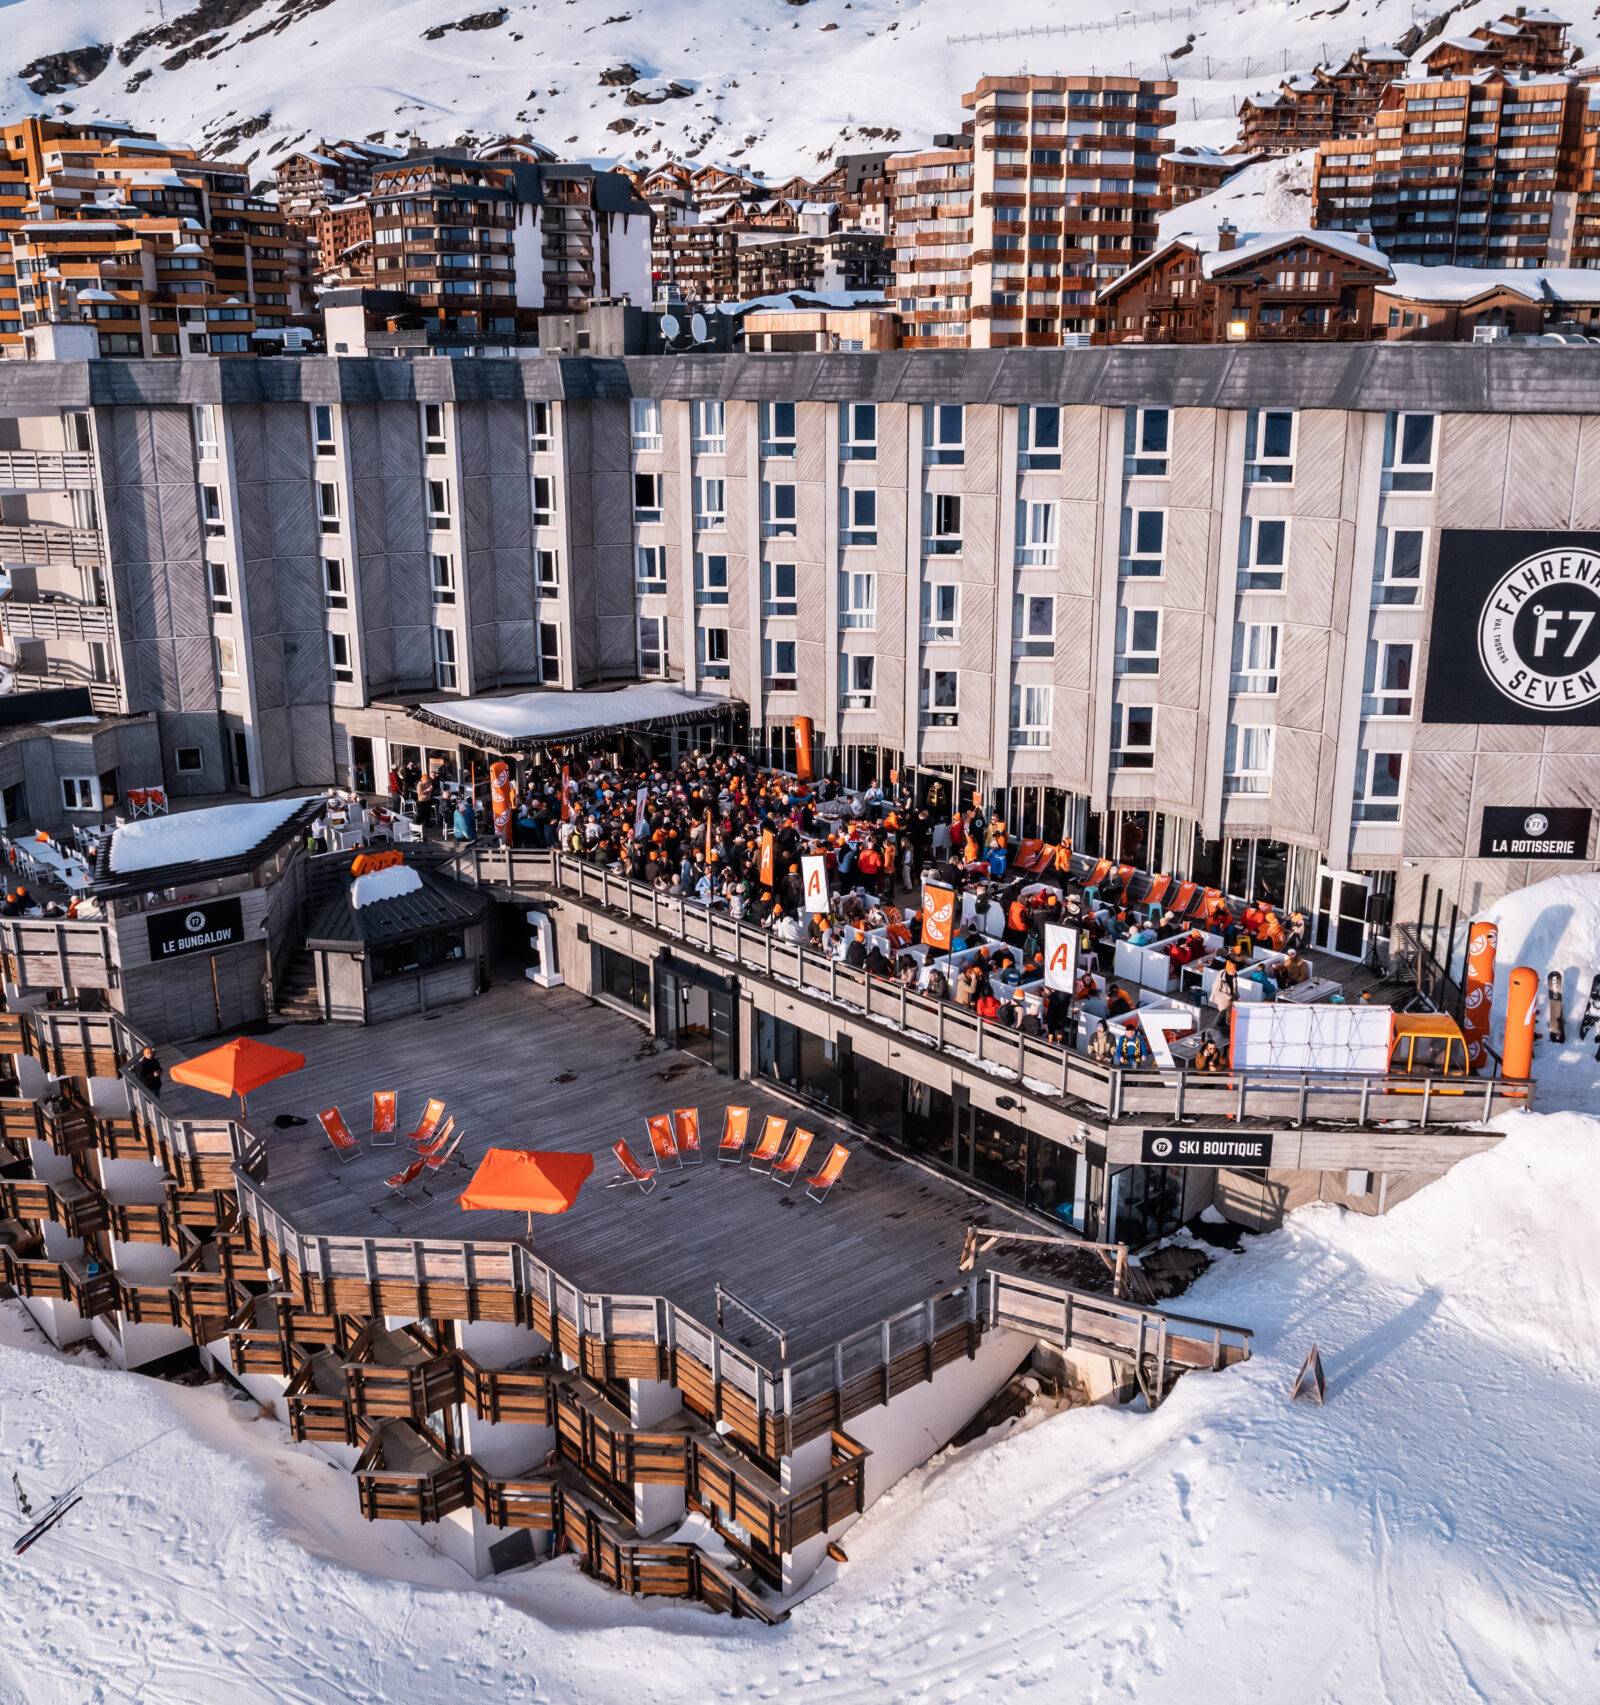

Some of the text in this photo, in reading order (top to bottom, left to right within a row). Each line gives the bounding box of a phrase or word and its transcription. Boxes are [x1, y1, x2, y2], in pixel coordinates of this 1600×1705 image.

[1493, 618, 1508, 664] VAL THORENS
[1508, 669, 1598, 702] SEVEN
[1492, 839, 1575, 854] LA ROTISSERIE
[807, 870, 821, 897] A
[162, 928, 232, 954] LE BUNGALOW
[1049, 943, 1068, 971] A
[1178, 1140, 1263, 1157] SKI BOUTIQUE
